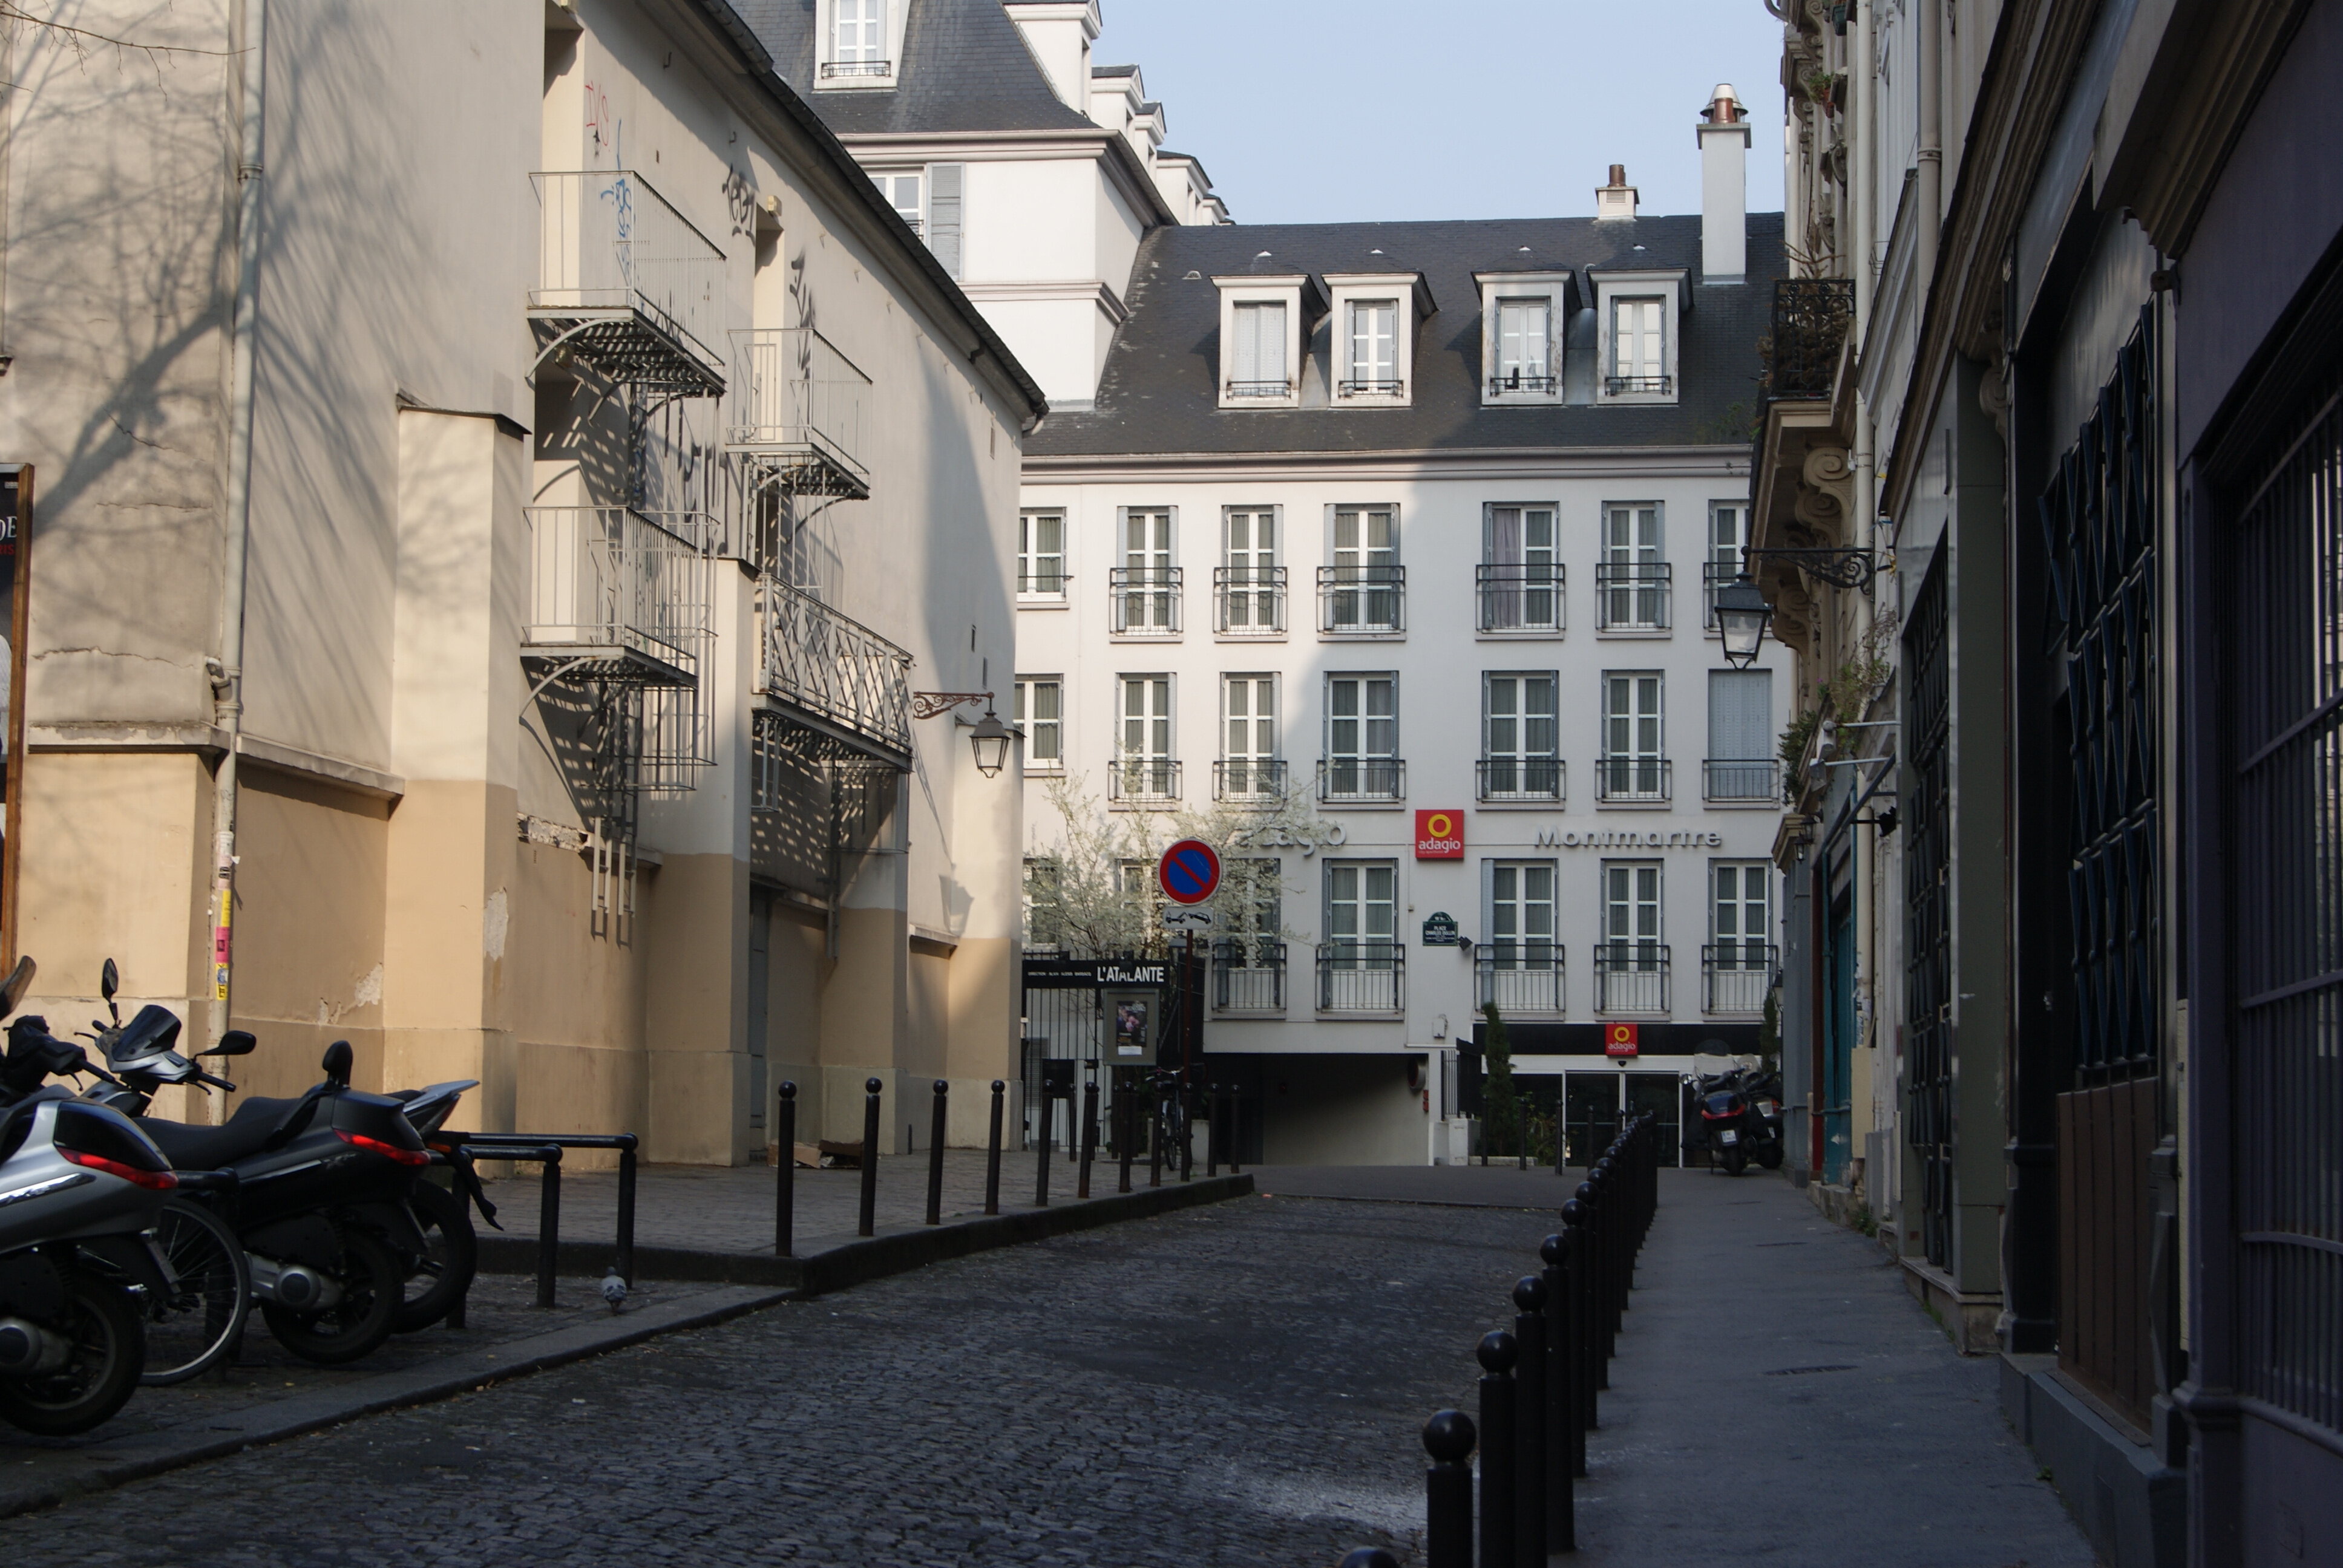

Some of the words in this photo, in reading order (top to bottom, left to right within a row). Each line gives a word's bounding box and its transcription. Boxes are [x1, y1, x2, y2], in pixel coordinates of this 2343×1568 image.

[1535, 825, 1722, 848] Montmartre
[1418, 837, 1461, 854] adagio
[1097, 966, 1164, 982] L'ATALANTE
[1608, 1042, 1636, 1052] adagio
